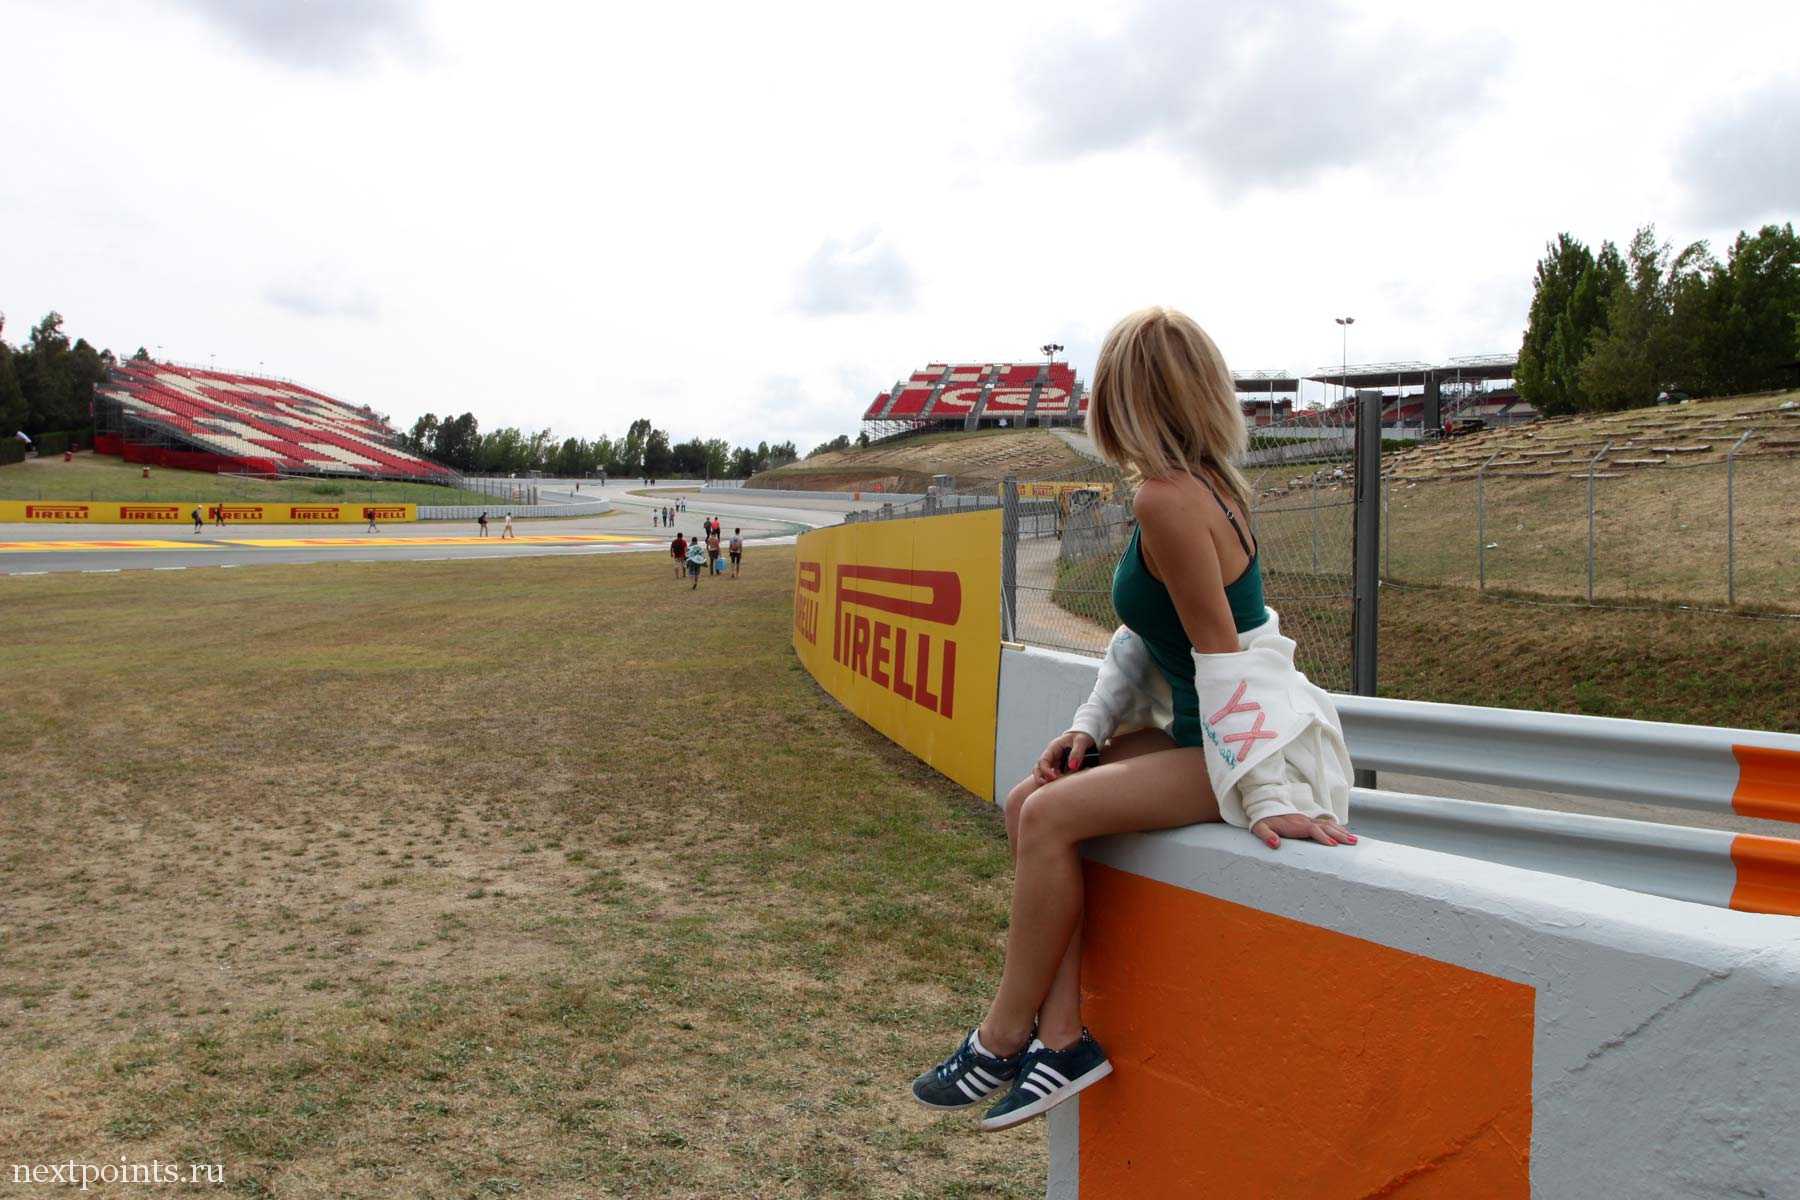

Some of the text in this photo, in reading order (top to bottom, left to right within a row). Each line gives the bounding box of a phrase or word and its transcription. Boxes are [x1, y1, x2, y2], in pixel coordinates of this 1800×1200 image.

[25, 505, 89, 519] PIRELLI
[119, 506, 179, 520] PIRELLI
[208, 507, 263, 520] PRELLI
[290, 507, 339, 520] PIRELLI
[362, 507, 406, 519] PRELLI
[833, 564, 962, 720] PIRELLI
